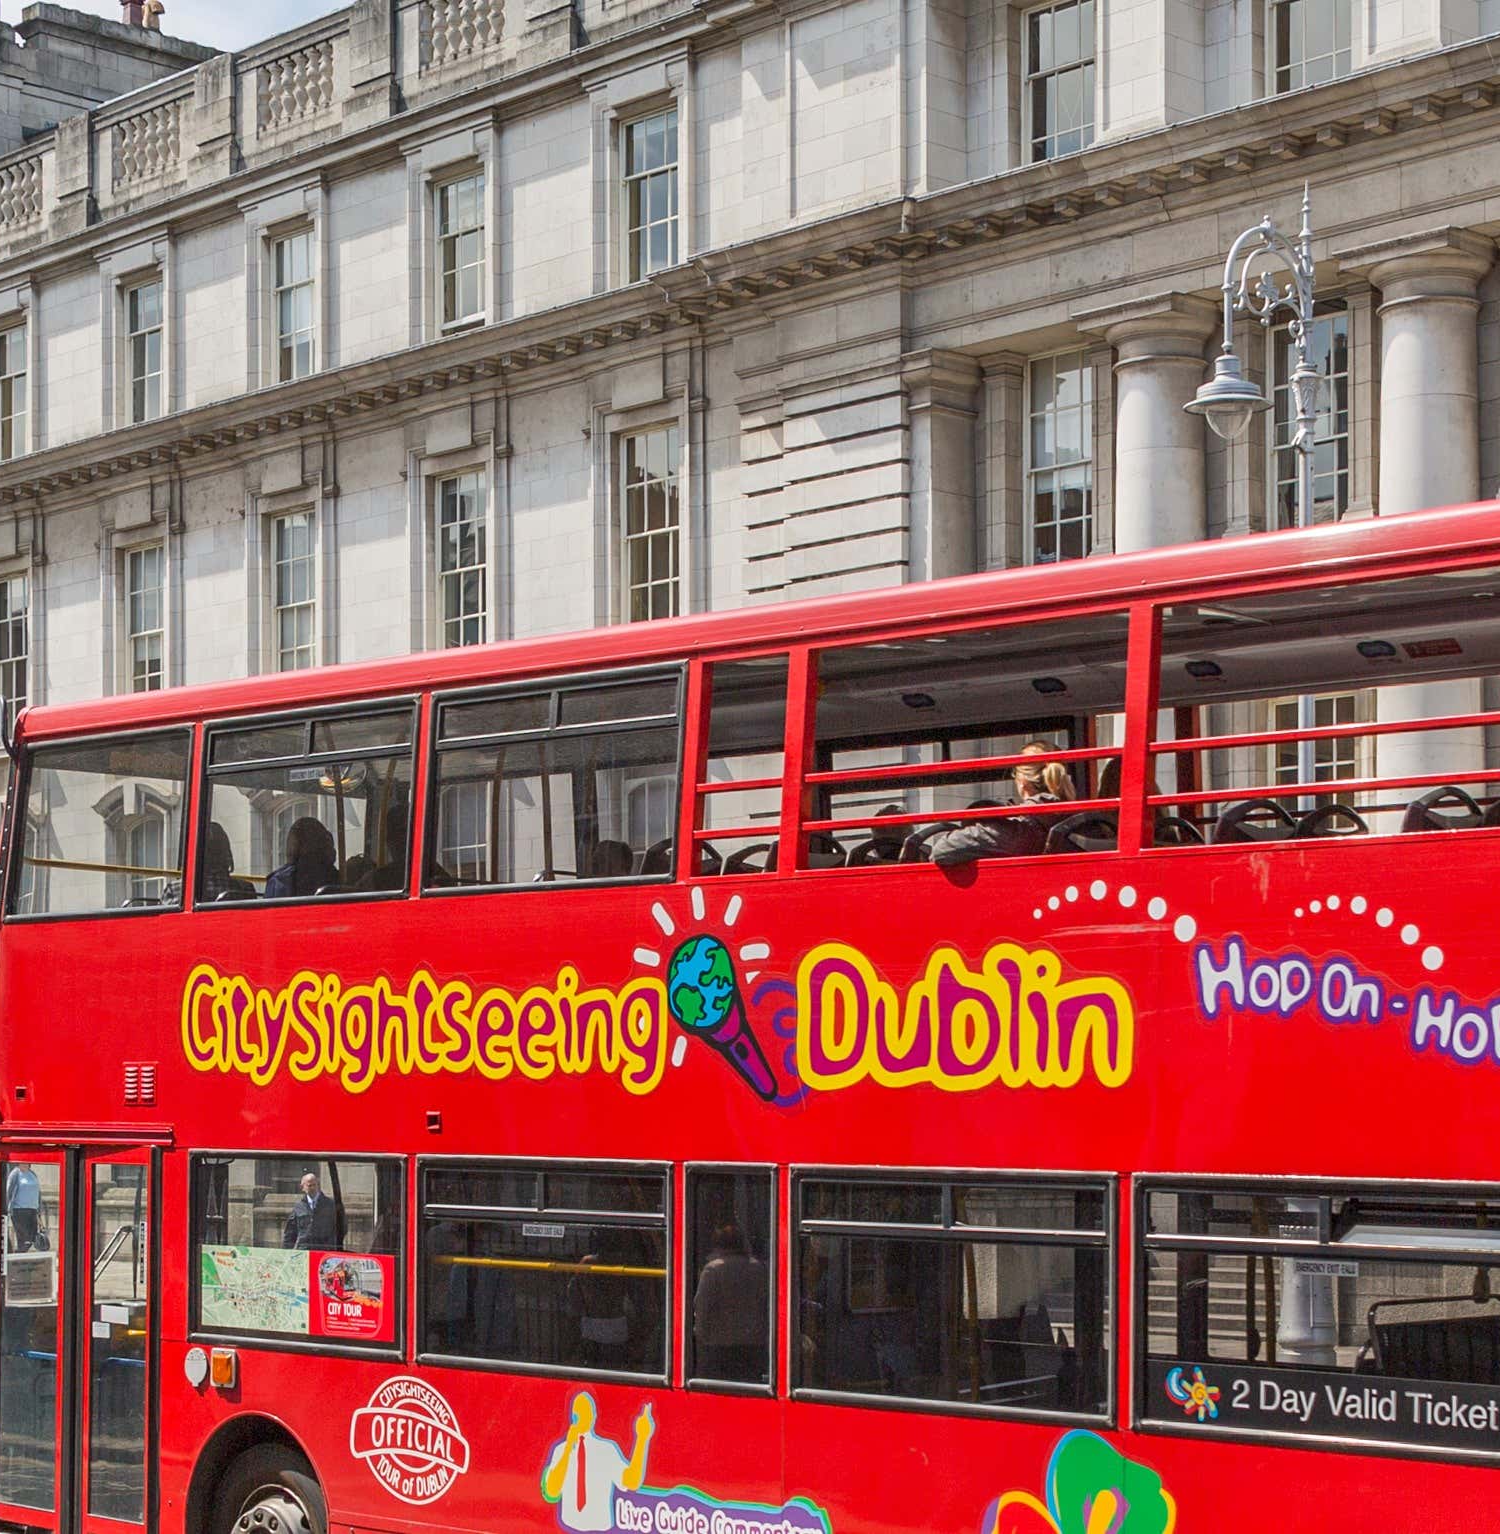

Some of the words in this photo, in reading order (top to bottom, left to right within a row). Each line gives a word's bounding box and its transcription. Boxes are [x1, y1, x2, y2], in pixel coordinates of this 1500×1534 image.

[1195, 939, 1314, 1016] Hop
[1320, 961, 1381, 1020] On
[182, 963, 668, 1095] CitySightseeing
[797, 943, 1134, 1092] Dublin
[327, 1302, 342, 1315] CITY
[343, 1303, 363, 1317] TOUR
[379, 1381, 451, 1425] CITYSIGHTSEEING
[1231, 1379, 1250, 1408] 2
[1259, 1380, 1316, 1422] Day
[1324, 1385, 1397, 1422] Valid
[1404, 1391, 1499, 1431] Ticket
[371, 1414, 455, 1462] OFFICIAL
[376, 1454, 401, 1489] TOUR
[402, 1477, 414, 1495] of
[416, 1466, 449, 1497] DUBLIN
[615, 1498, 653, 1531] Live
[654, 1501, 709, 1534] Guide
